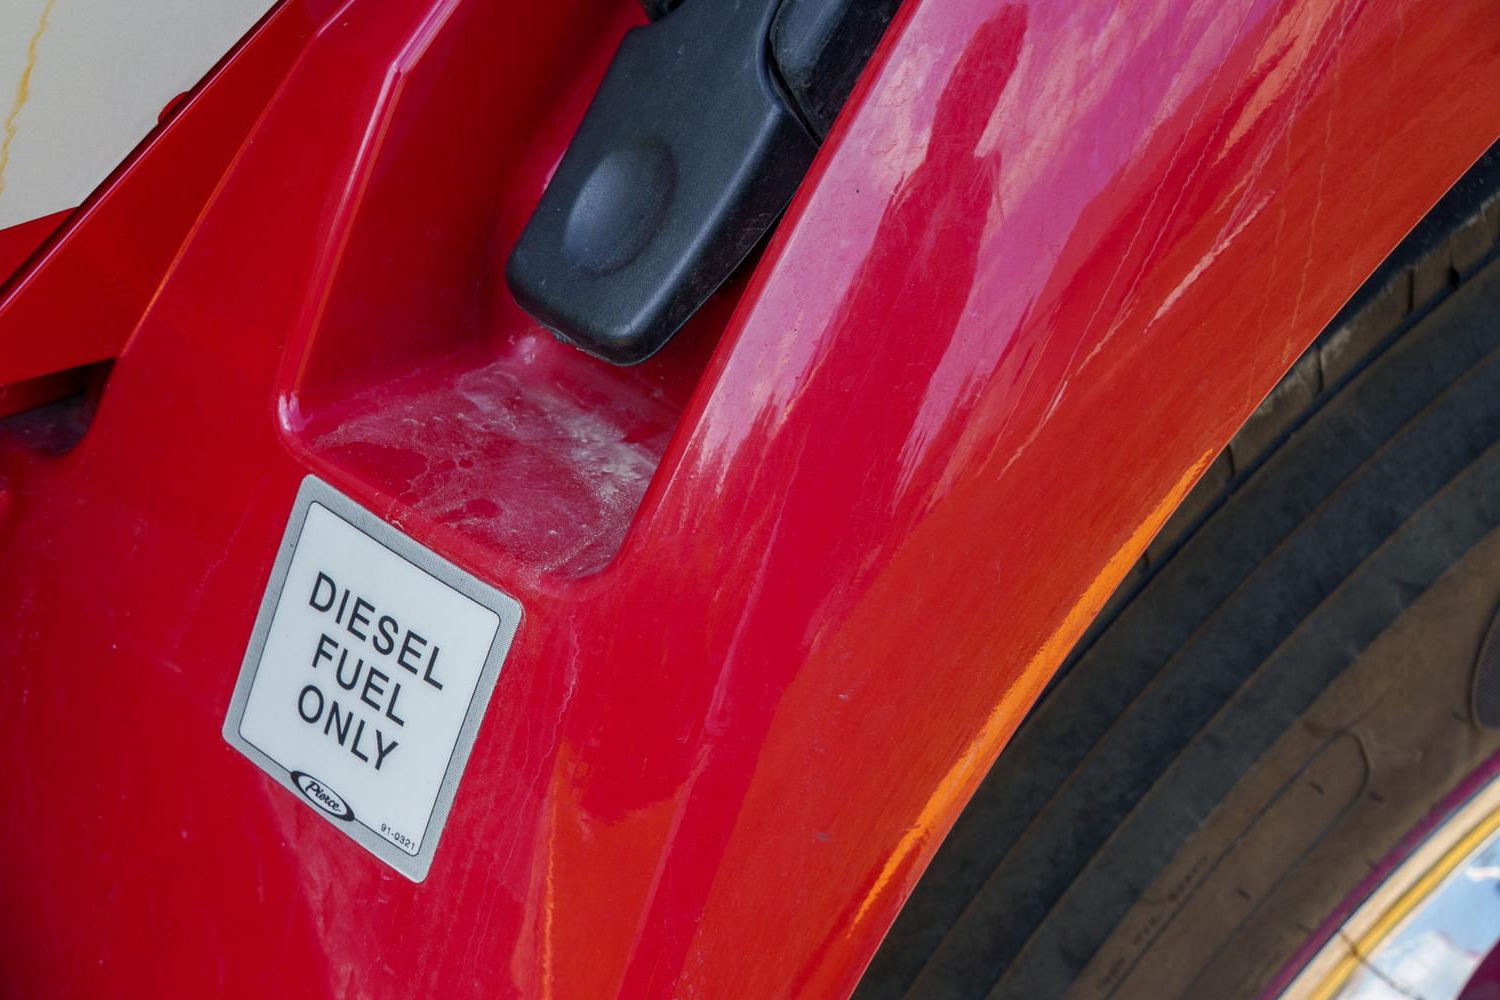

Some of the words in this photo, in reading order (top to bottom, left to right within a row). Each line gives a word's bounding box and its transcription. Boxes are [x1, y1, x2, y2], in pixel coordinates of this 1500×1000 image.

[309, 571, 443, 691] DIESEL
[312, 633, 405, 727] FUEL
[298, 684, 399, 771] ONLY
[304, 780, 341, 812] Pierce
[380, 823, 415, 850] 91-0321
